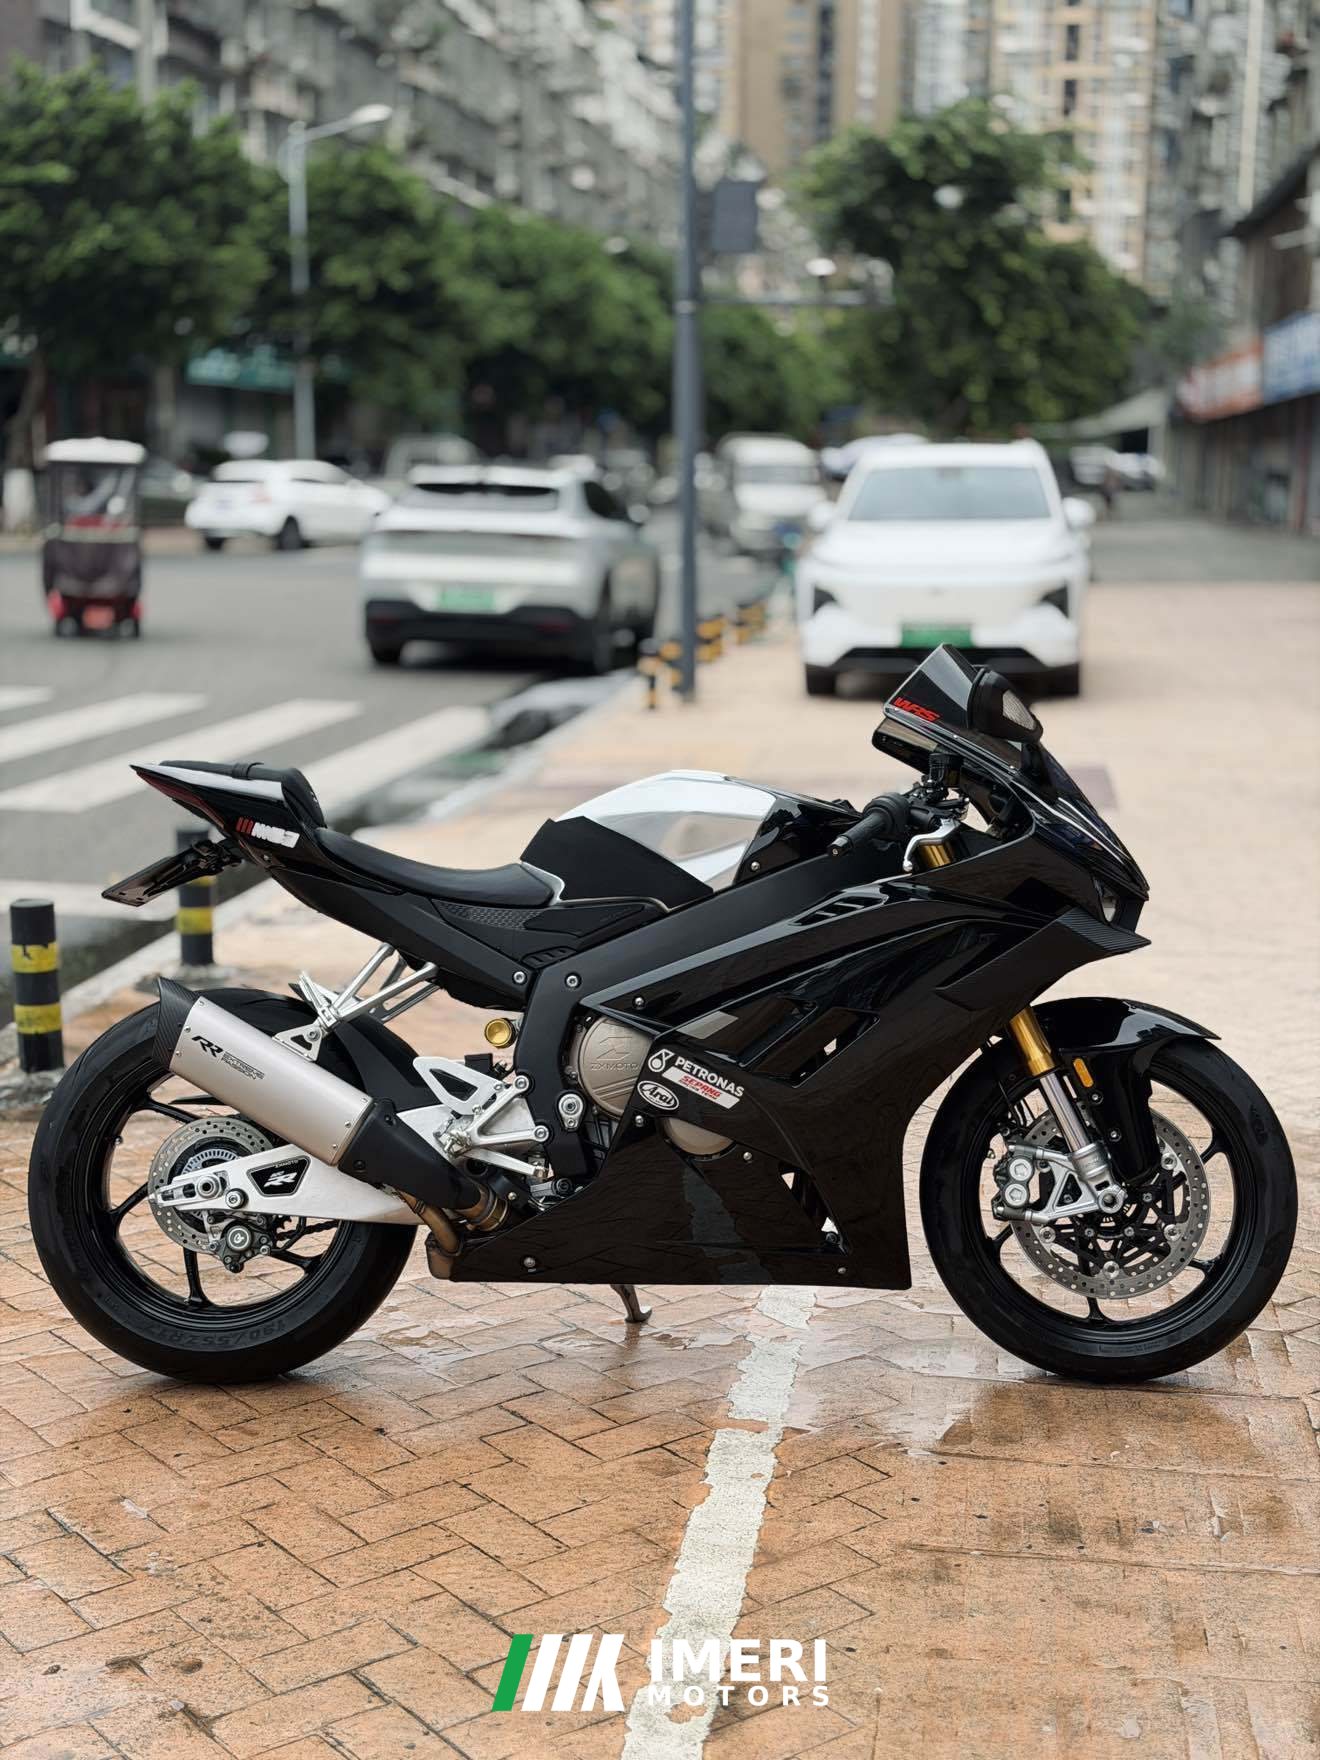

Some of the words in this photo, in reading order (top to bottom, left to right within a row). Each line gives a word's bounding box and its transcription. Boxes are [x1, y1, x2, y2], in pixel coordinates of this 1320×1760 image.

[894, 697, 940, 721] WRS
[675, 1057, 744, 1097] PETRONAS
[643, 1085, 673, 1105] Arai
